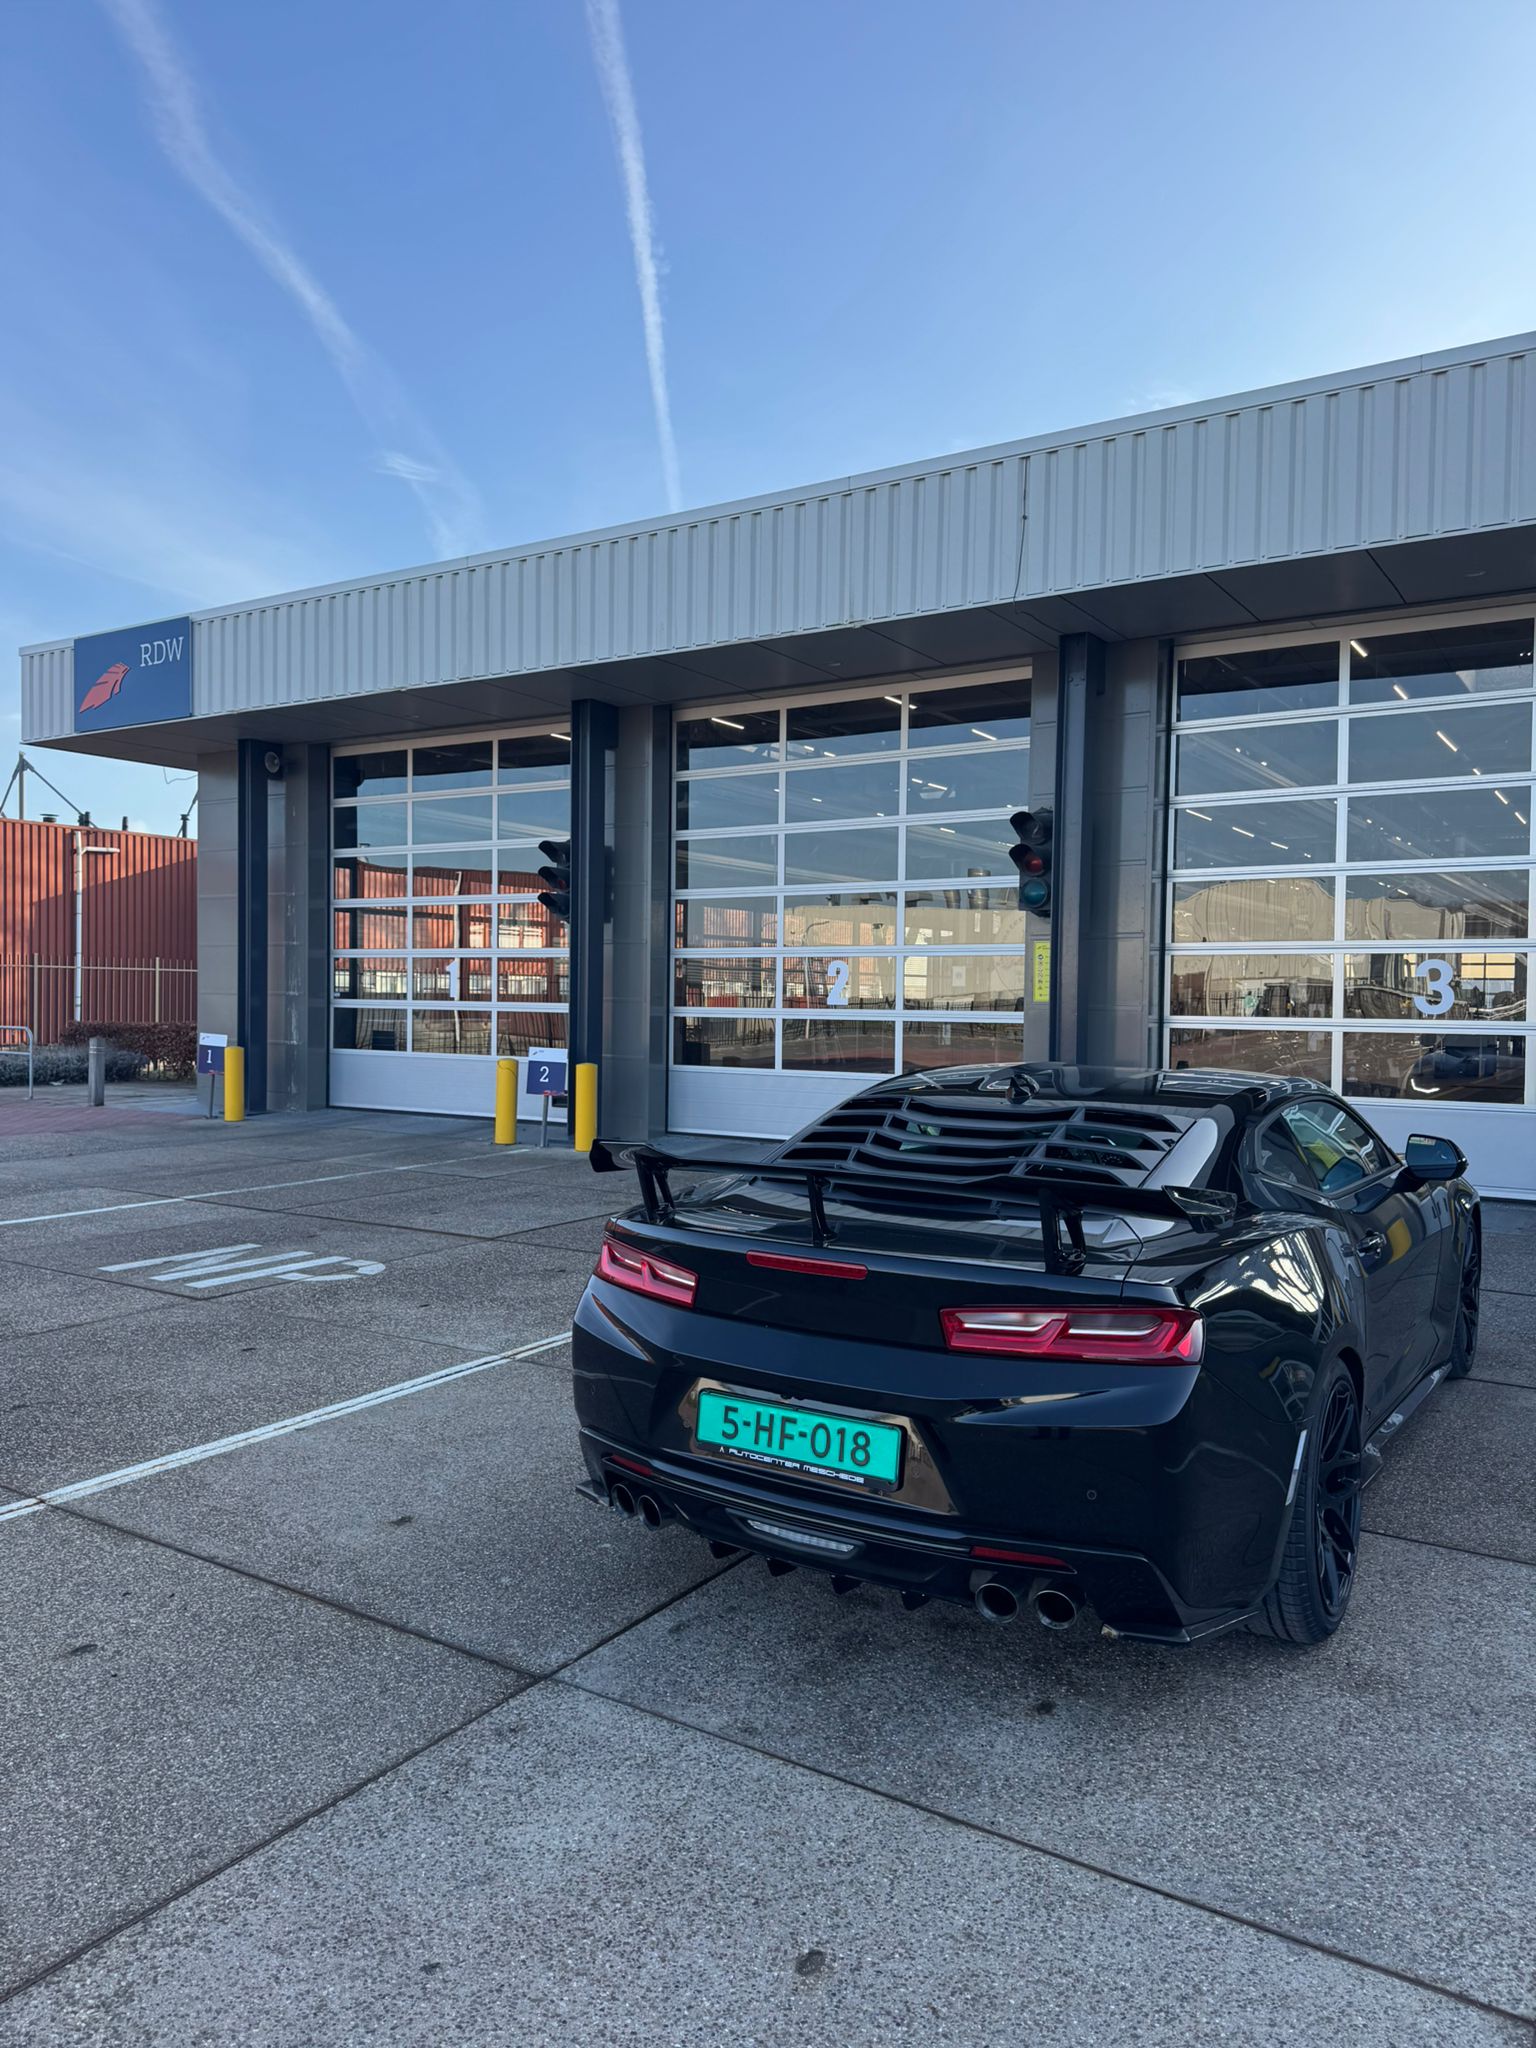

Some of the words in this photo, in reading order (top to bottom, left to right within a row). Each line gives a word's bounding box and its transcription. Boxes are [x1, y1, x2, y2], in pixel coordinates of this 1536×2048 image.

[140, 636, 184, 667] RDW
[445, 959, 458, 998] 1
[827, 960, 849, 1006] 2
[1414, 959, 1454, 1015] 3
[206, 1049, 212, 1064] 1
[539, 1065, 550, 1083] 2
[721, 1405, 872, 1467] 5-HF-018
[728, 1447, 800, 1470] AUTOCENTER
